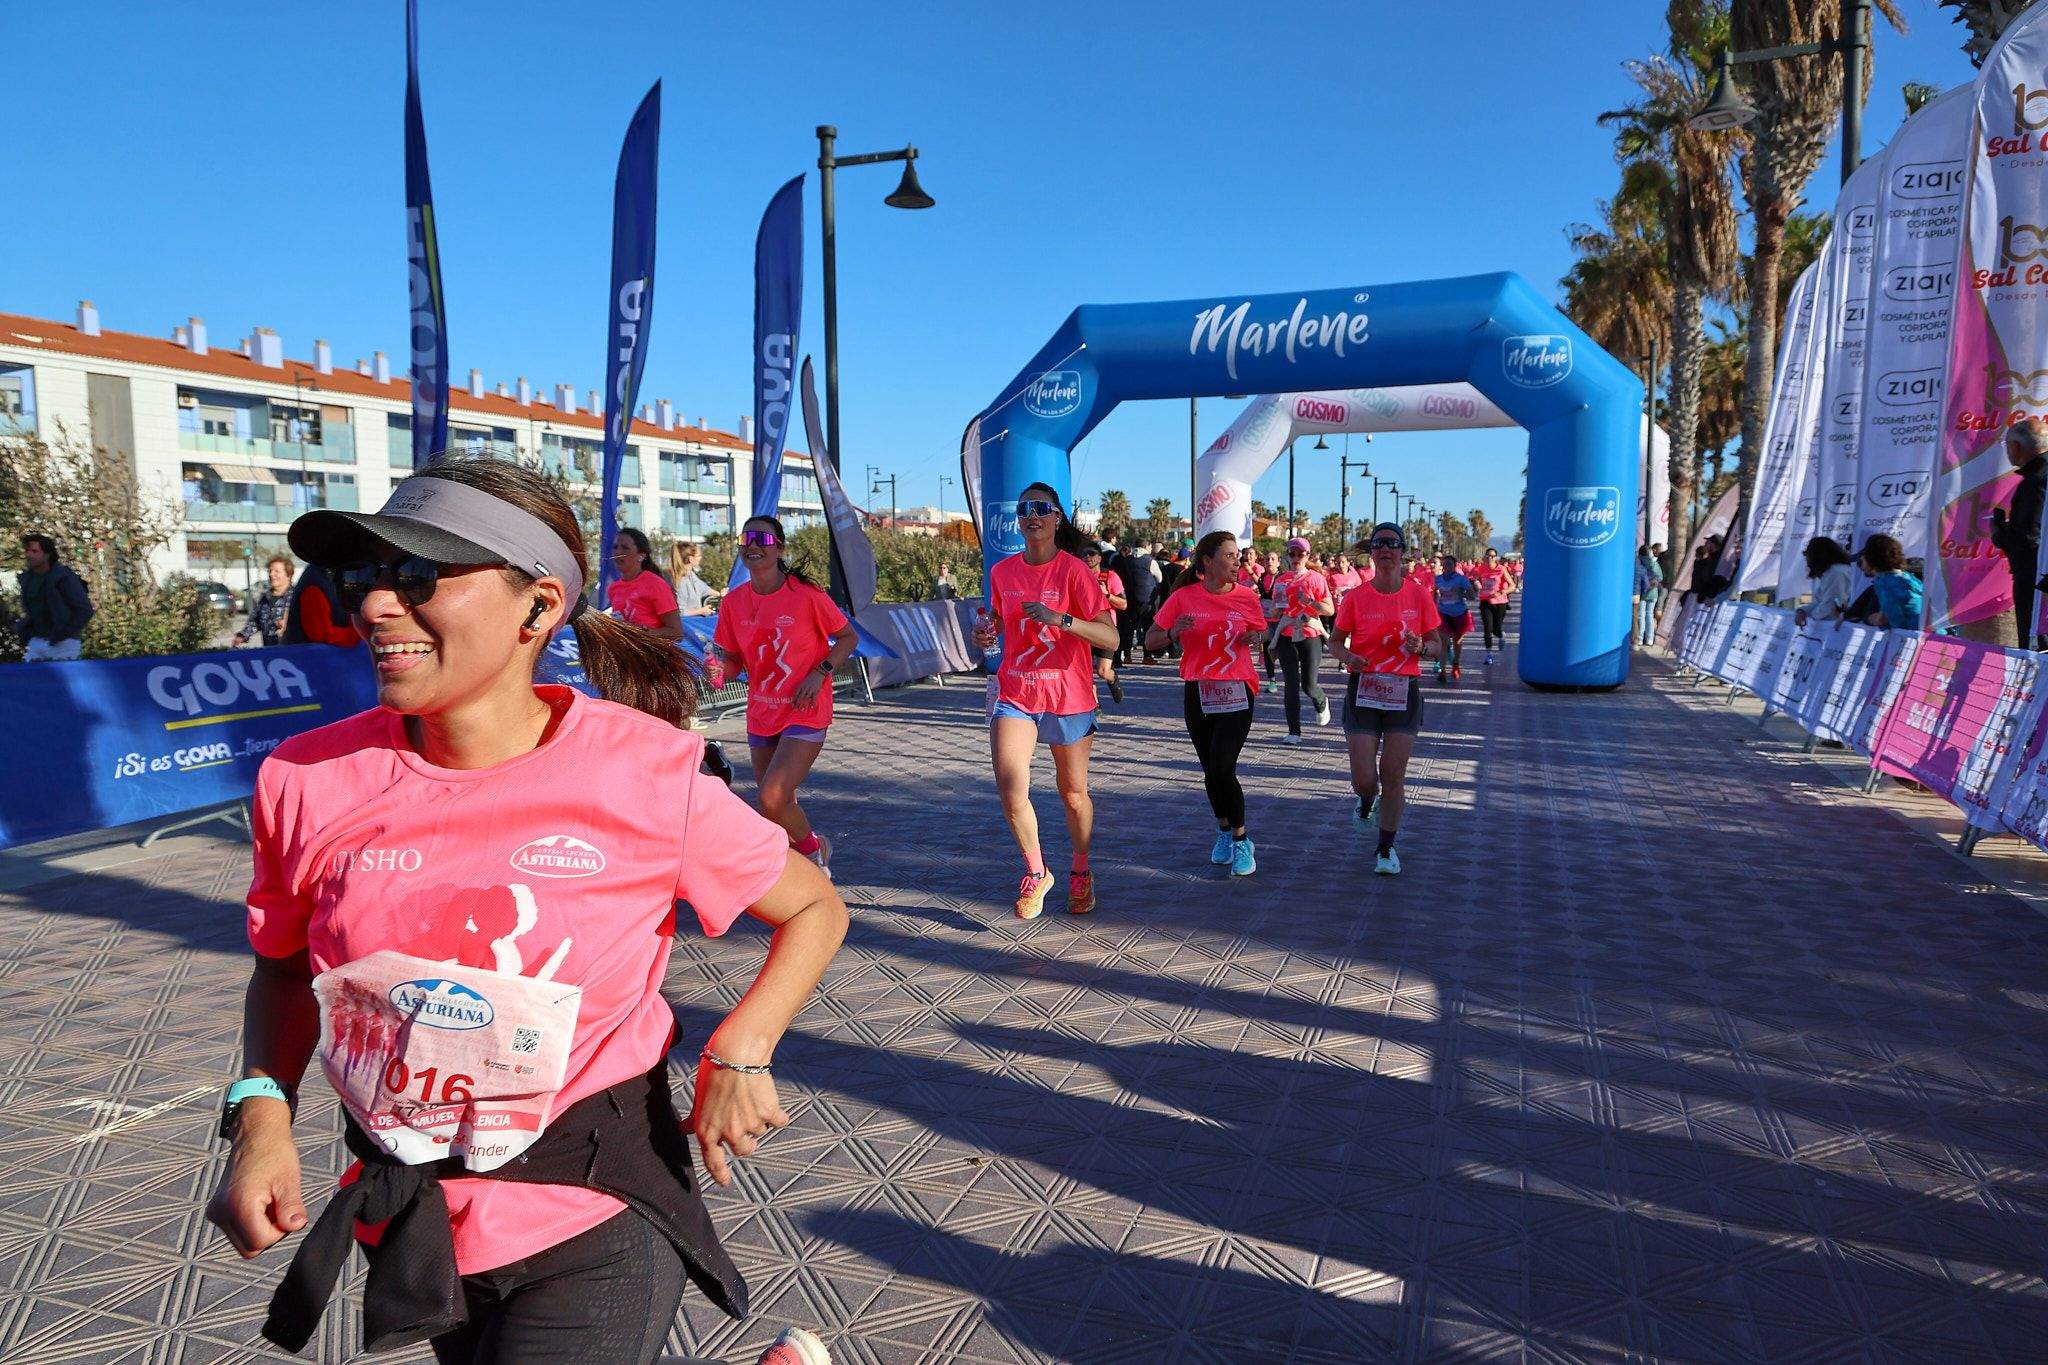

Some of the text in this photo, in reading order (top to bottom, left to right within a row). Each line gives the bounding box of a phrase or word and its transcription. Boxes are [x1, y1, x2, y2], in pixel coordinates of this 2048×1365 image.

[1987, 134, 2031, 157] Sal
[1972, 266, 2017, 289] Sal
[1508, 346, 1567, 374] Marlene
[1028, 382, 1077, 405] Marlene
[1888, 379, 1941, 398] ziaj
[1297, 399, 1345, 423] COSMO
[1424, 396, 1474, 419] COSMO
[1955, 410, 2000, 431] Sal
[1549, 500, 1615, 531] Marlene
[1941, 540, 1981, 560] Sal
[147, 658, 313, 716] GOYA
[1215, 686, 1233, 696] 016
[1375, 685, 1394, 694] 016
[150, 756, 173, 772] es
[175, 742, 233, 768] GOYA
[517, 851, 598, 870] ASTURIANA
[397, 989, 485, 1024] ASTURIANA
[386, 1057, 475, 1105] 016
[378, 1116, 394, 1127] DE
[412, 1111, 456, 1127] MUJER
